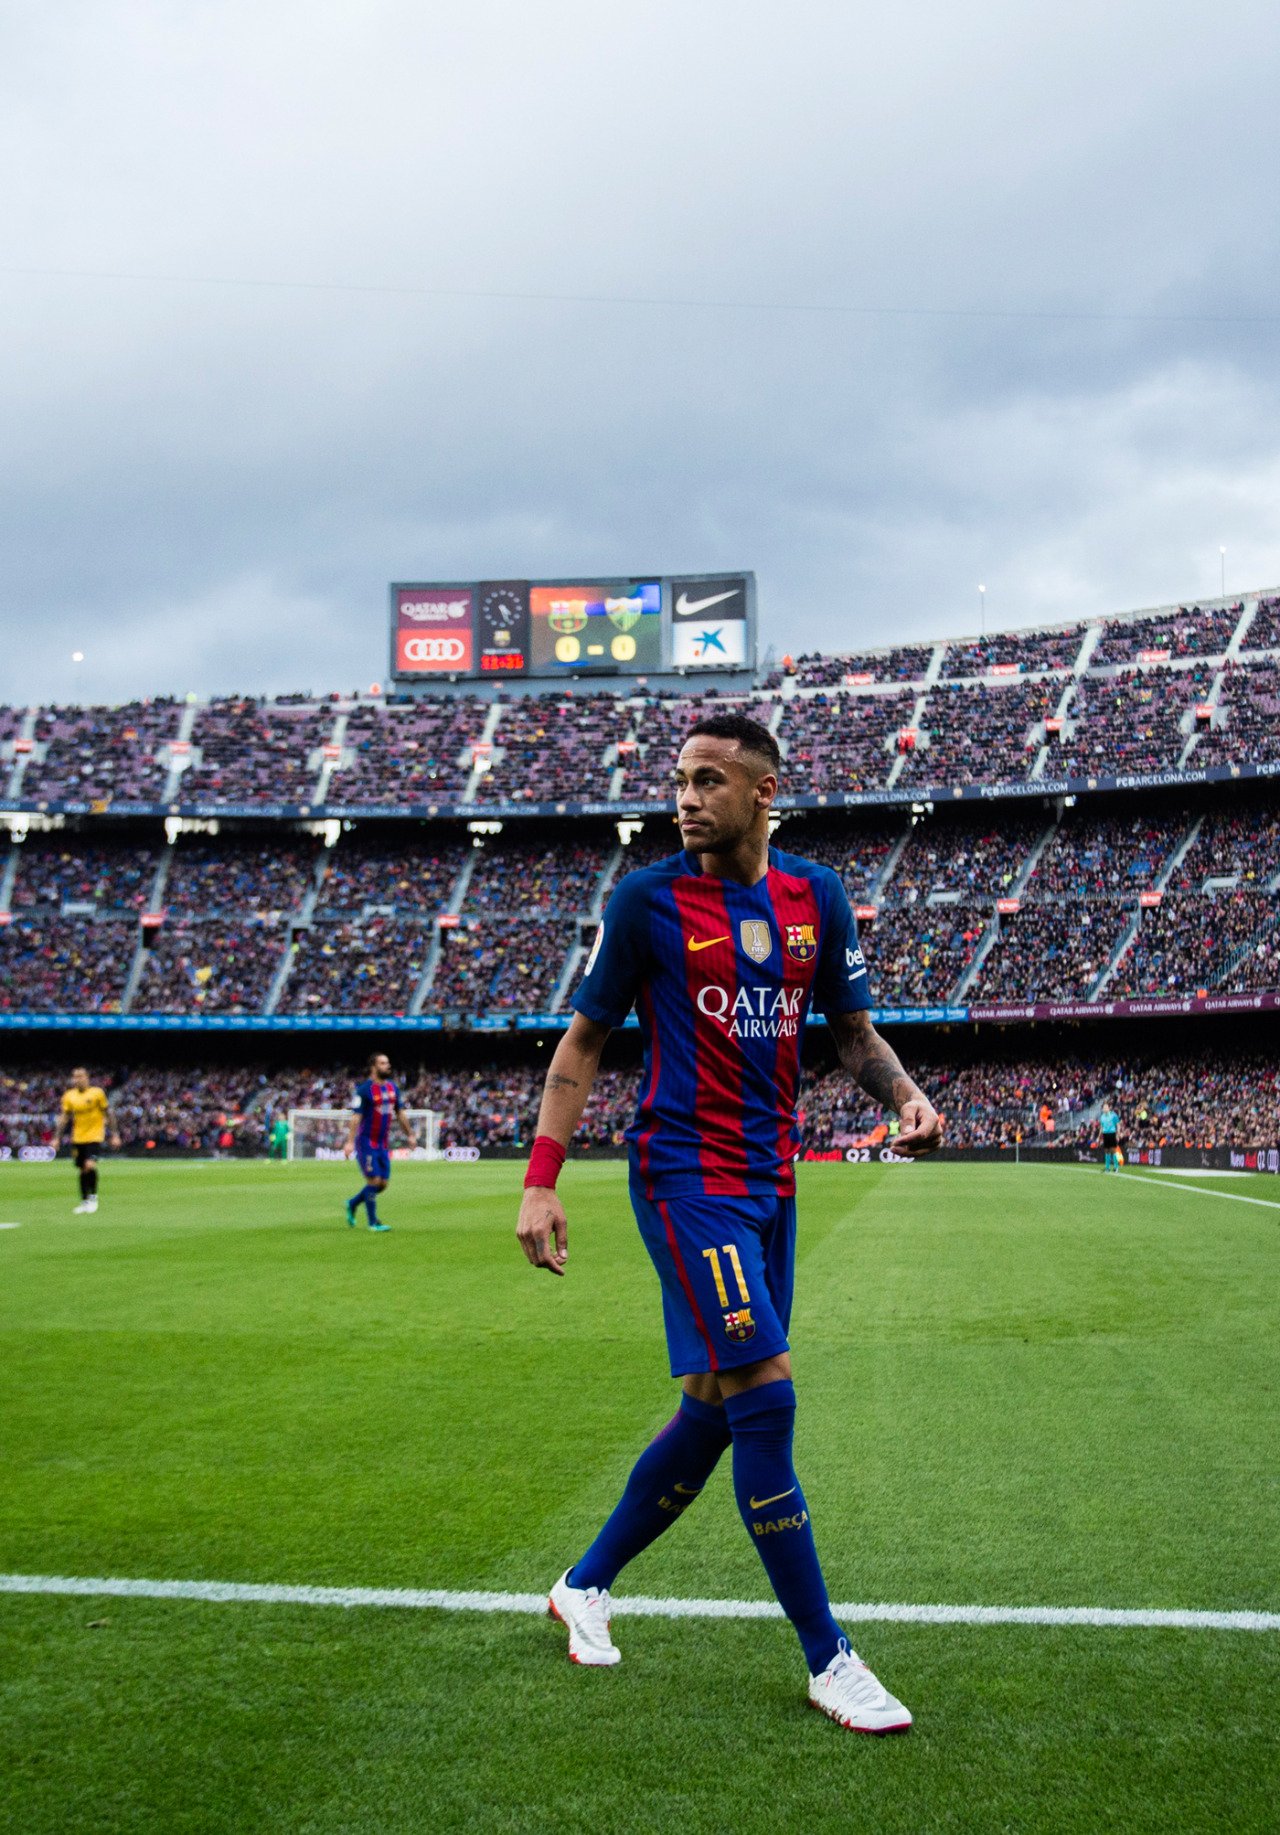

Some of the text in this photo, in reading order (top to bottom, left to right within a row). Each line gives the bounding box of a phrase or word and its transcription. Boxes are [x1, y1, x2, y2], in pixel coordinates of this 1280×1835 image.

[555, 635, 581, 662] 0
[611, 634, 637, 661] 0
[1116, 771, 1207, 788] FCBARCELONA.COM
[981, 782, 1069, 797] FCBARCELONA.COM
[844, 791, 931, 804] FCBARCELONA.COM
[697, 985, 804, 1023] QATAR
[1050, 1005, 1103, 1016] QATAR AIRWAYS
[1129, 1002, 1181, 1013] QATAR AIRWAYS
[1205, 999, 1253, 1010] QATAR AIRWAYS
[971, 1008, 1024, 1018] QATAR AIRWAYS
[728, 1017, 798, 1038] AIRWAYS
[804, 1149, 842, 1162] Audi
[846, 1148, 870, 1163] Q2
[702, 1244, 750, 1308] 11
[752, 1510, 809, 1536] BARÇA
